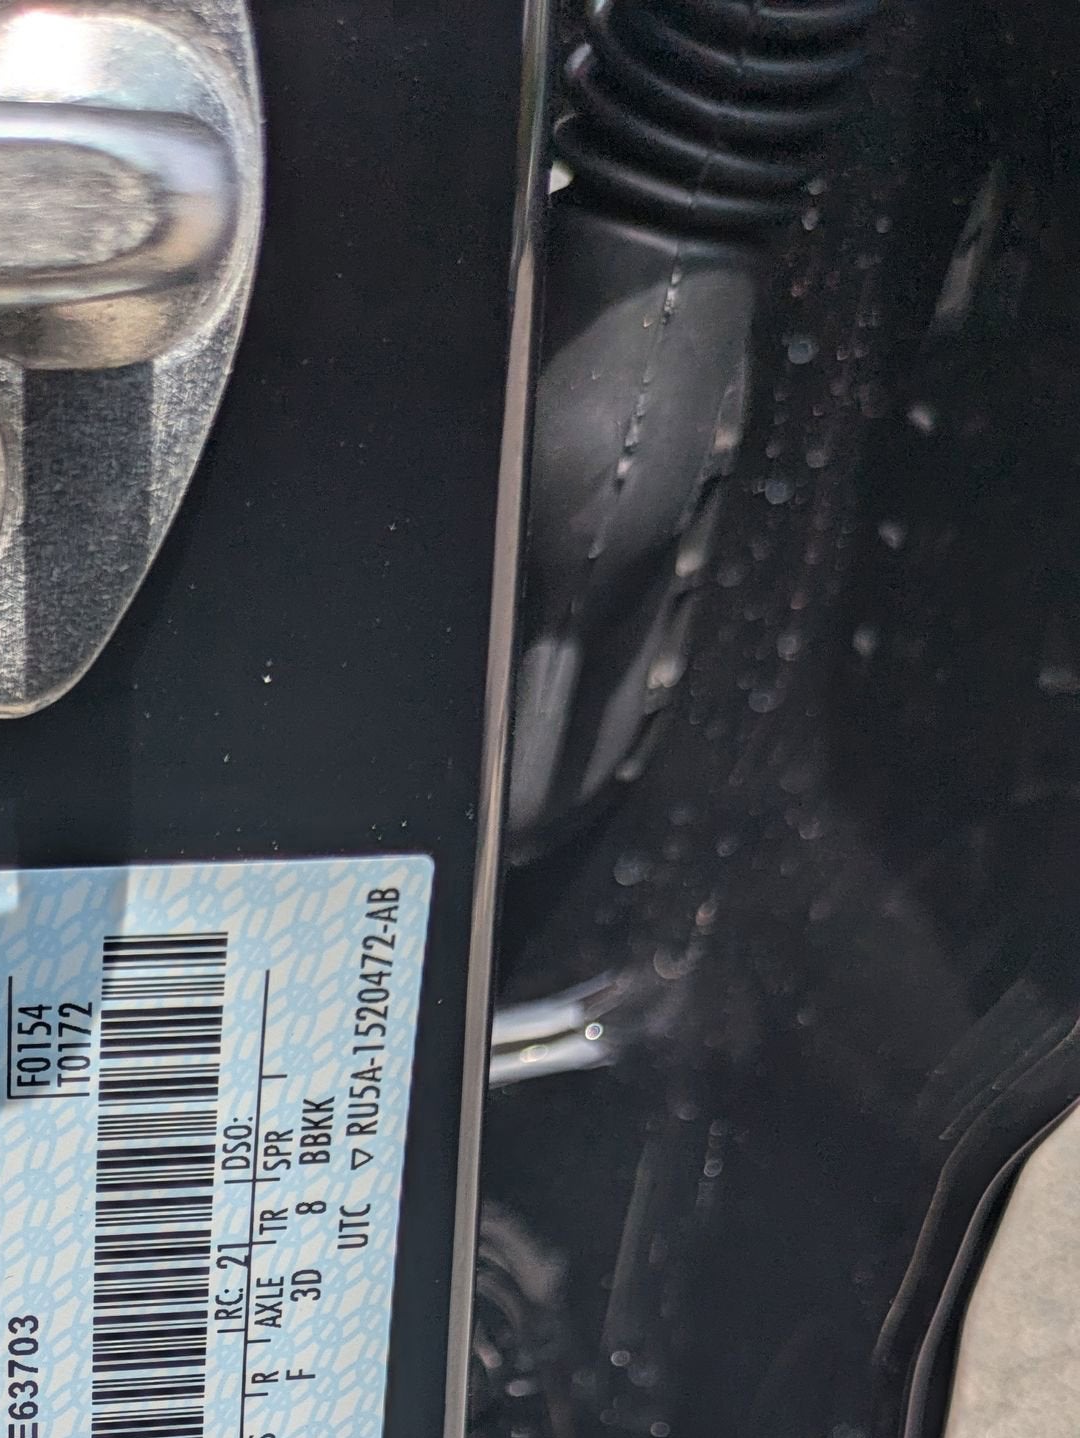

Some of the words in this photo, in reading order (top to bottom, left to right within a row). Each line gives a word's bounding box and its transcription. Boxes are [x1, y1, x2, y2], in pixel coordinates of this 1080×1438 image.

[345, 887, 401, 1137] RU5A-1520472-AB
[16, 1004, 53, 1087] F0154
[56, 1001, 93, 1088] T0172
[221, 1116, 254, 1171] DSO:
[262, 1128, 294, 1172] SPR
[298, 1096, 335, 1165] BBKK
[258, 1207, 289, 1236] TR
[295, 1200, 327, 1215] 8
[337, 1203, 371, 1250] UTC
[215, 1239, 251, 1272] 21
[214, 1287, 244, 1321] RC:
[254, 1276, 285, 1329] AXLE
[289, 1268, 322, 1302] 3D
[251, 1370, 280, 1384] R
[285, 1368, 316, 1381] F
